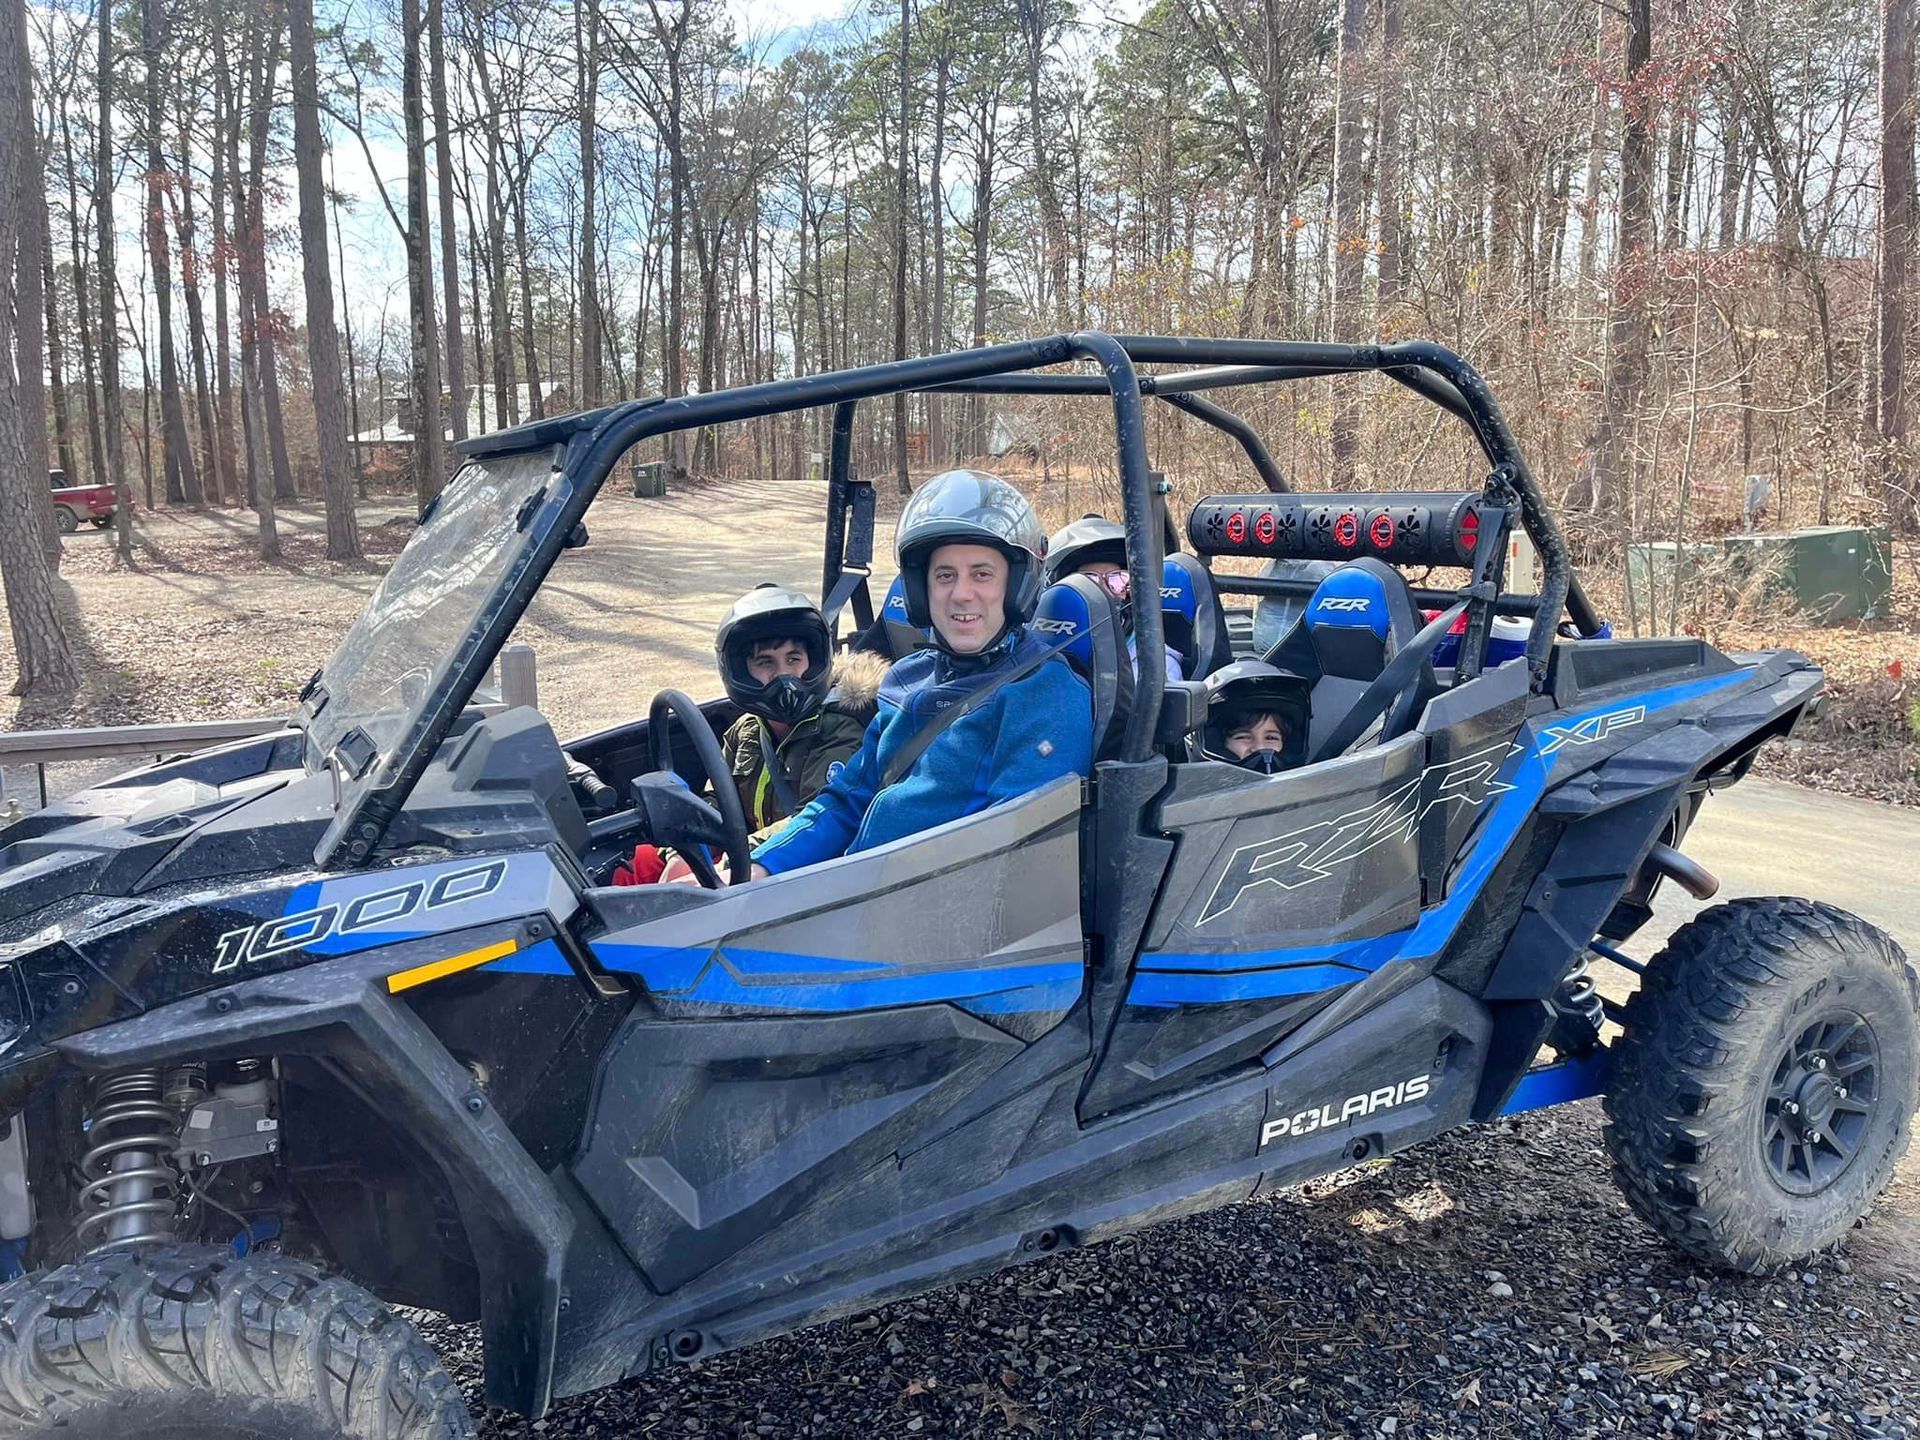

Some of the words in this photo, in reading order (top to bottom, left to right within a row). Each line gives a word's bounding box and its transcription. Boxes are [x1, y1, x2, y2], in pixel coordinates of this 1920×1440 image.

[887, 595, 905, 608] RZ
[1158, 587, 1182, 599] ZR
[1316, 597, 1371, 612] RZR
[1031, 617, 1078, 635] RZR
[1194, 741, 1524, 928] RZR
[1534, 705, 1645, 758] XP
[212, 858, 508, 974] 1000
[1260, 1075, 1430, 1147] POLARIS
